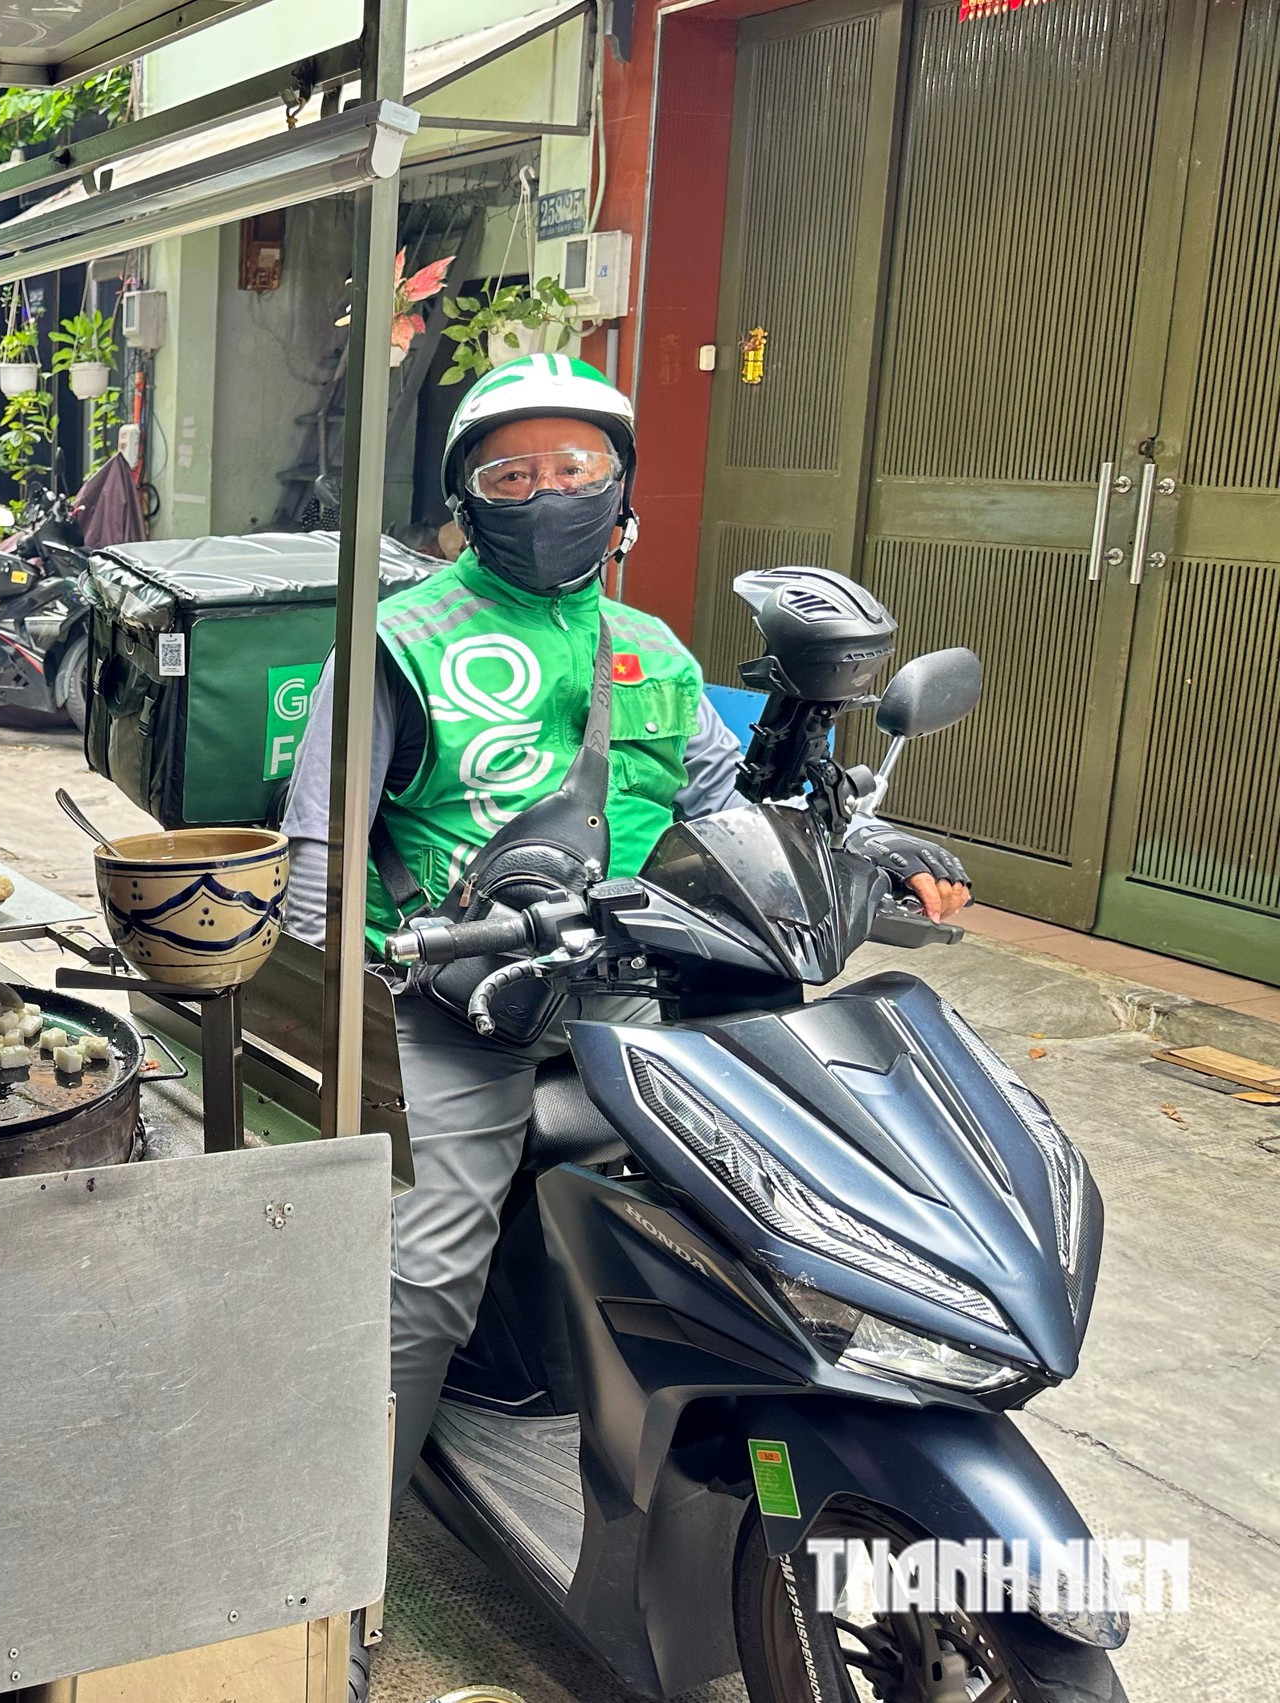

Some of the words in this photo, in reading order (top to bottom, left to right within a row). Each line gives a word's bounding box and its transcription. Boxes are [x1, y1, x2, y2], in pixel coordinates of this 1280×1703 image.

[270, 735, 303, 776] F
[623, 1201, 710, 1278] HONDA
[786, 1582, 800, 1606] 27
[791, 1605, 824, 1703] SUSPENSION
